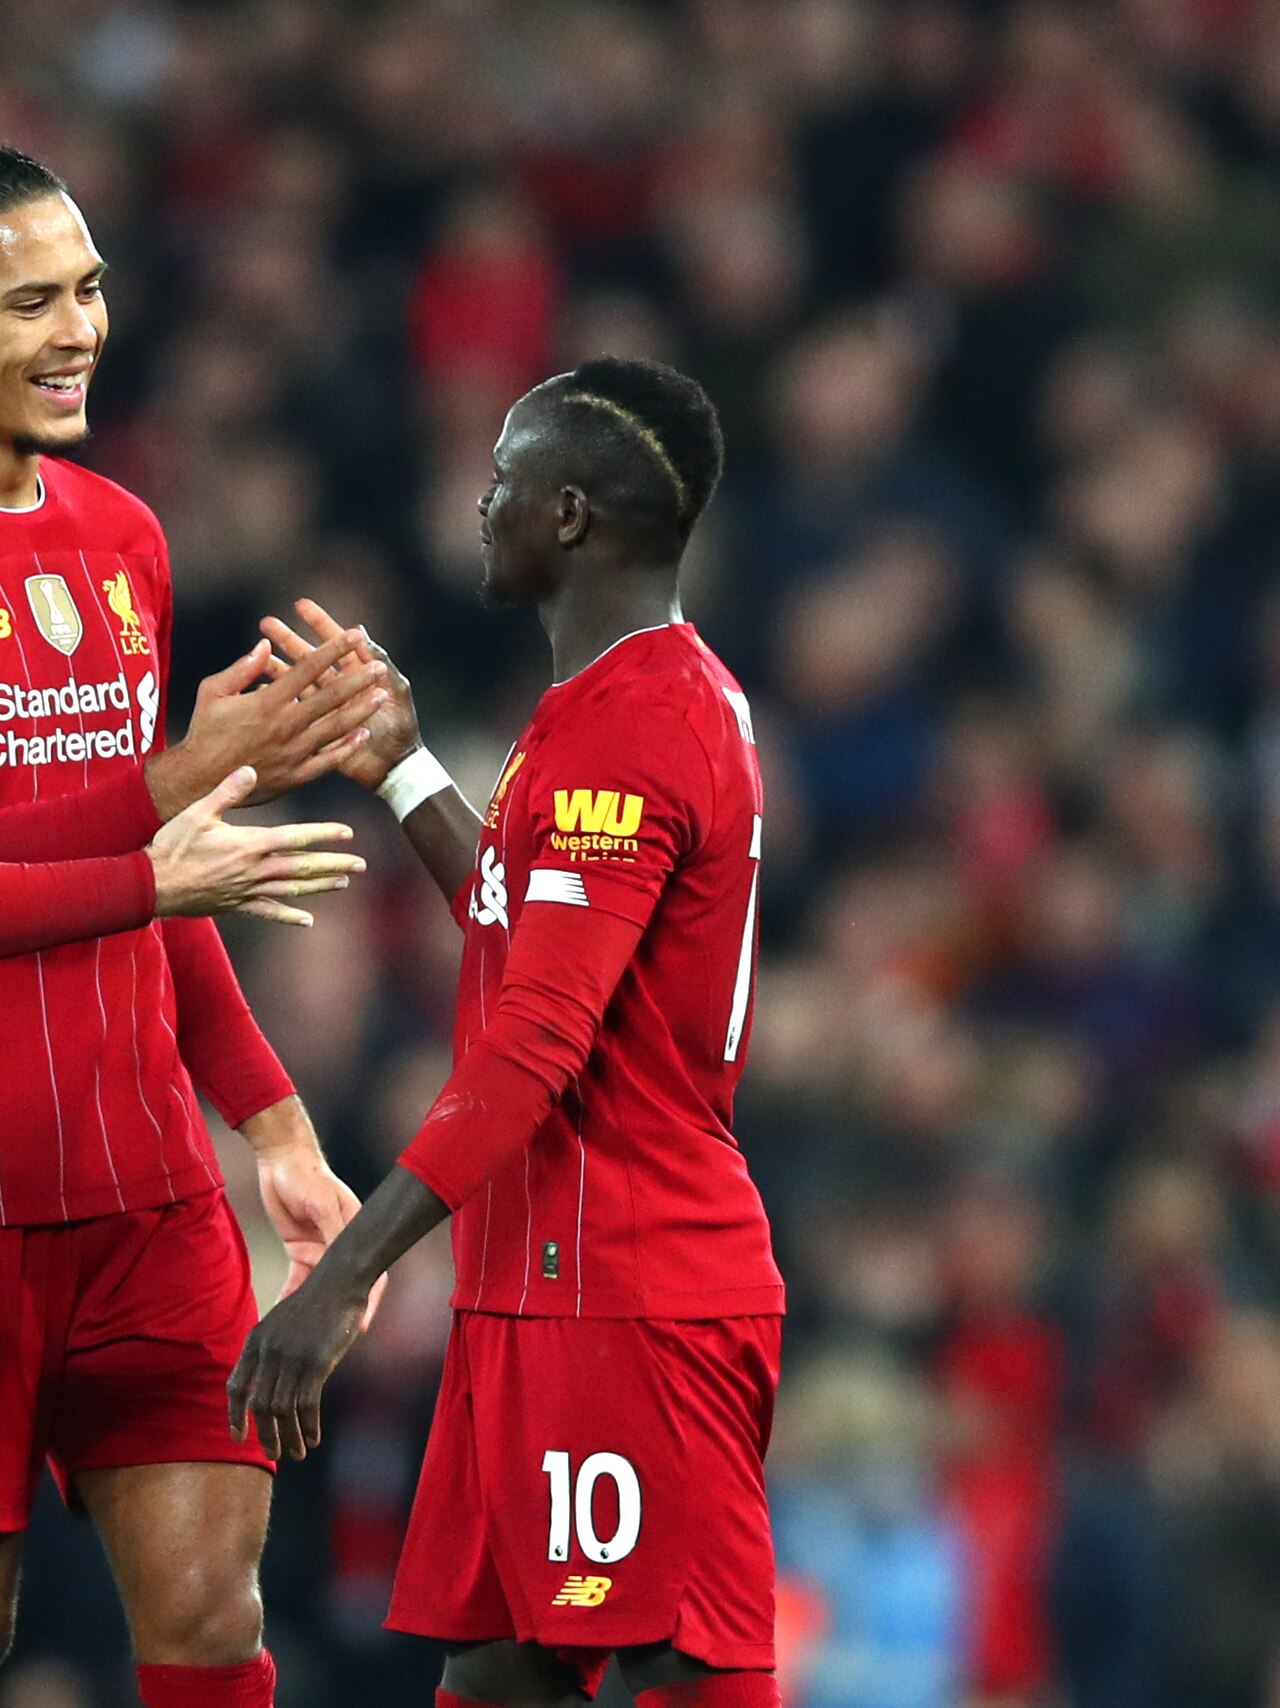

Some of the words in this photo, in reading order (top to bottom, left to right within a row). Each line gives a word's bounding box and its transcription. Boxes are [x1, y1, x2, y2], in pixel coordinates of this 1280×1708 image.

[554, 789, 644, 837] WU
[551, 832, 638, 852] Western
[541, 1450, 642, 1564] 10
